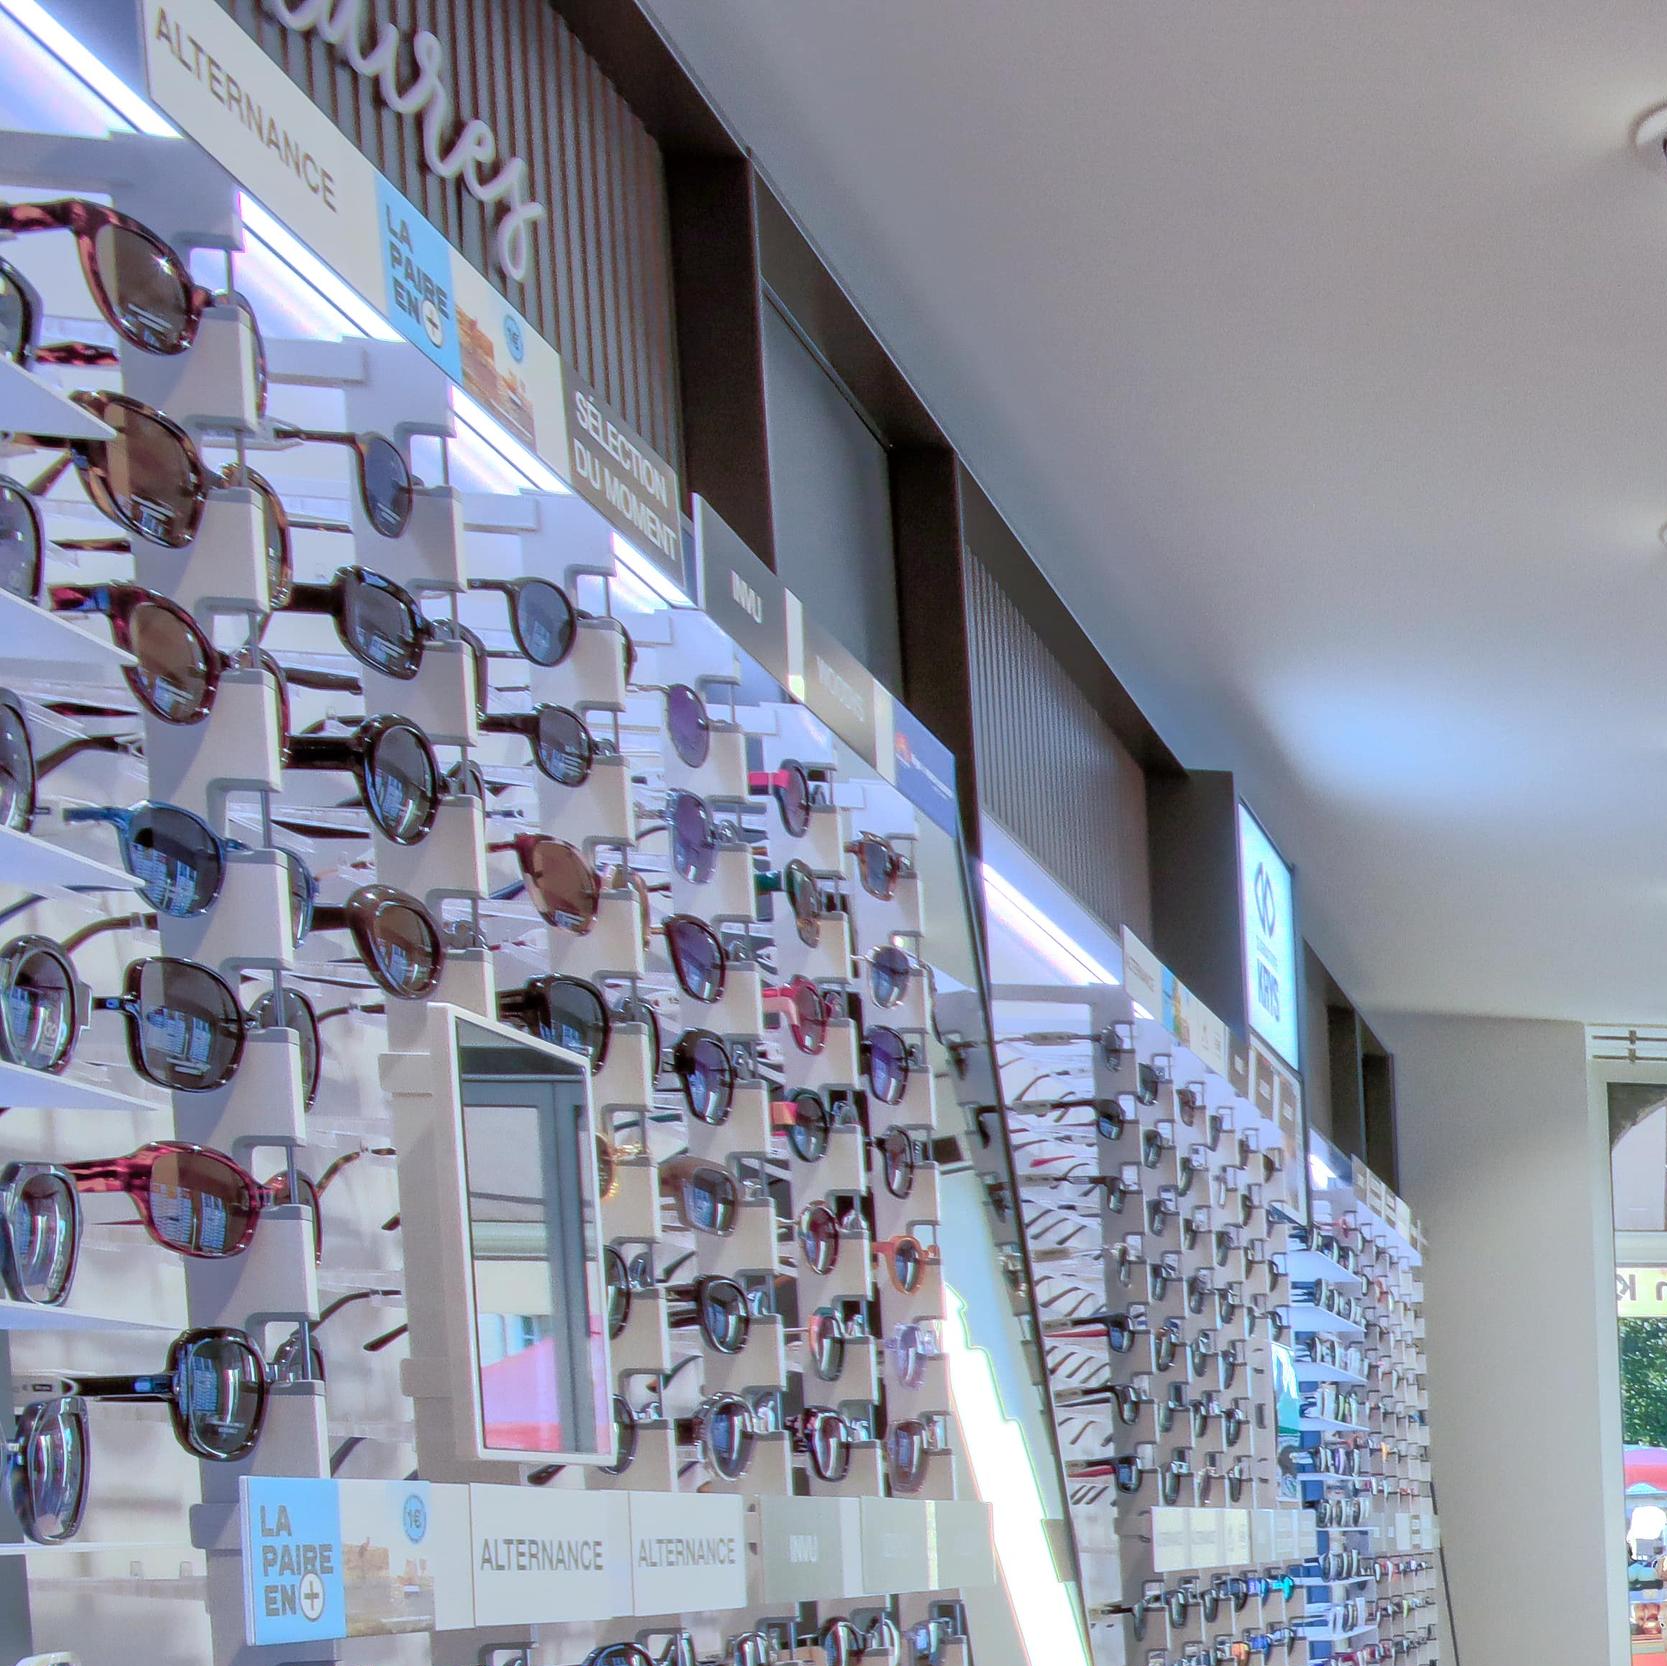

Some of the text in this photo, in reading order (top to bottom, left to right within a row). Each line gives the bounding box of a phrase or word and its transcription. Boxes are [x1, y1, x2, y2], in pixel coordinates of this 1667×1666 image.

[155, 7, 338, 214] ALTERNANCE
[386, 203, 414, 253] LA
[389, 244, 449, 319] PAIRE
[575, 391, 668, 507] SÉLECTION
[574, 437, 677, 560] DU MOMENT
[260, 1505, 292, 1537] LA
[262, 1544, 334, 1577] PAIRE
[480, 1539, 604, 1572] ALTERNANCE
[637, 1538, 737, 1567] ALTERNANCE
[264, 1584, 297, 1617] EN
